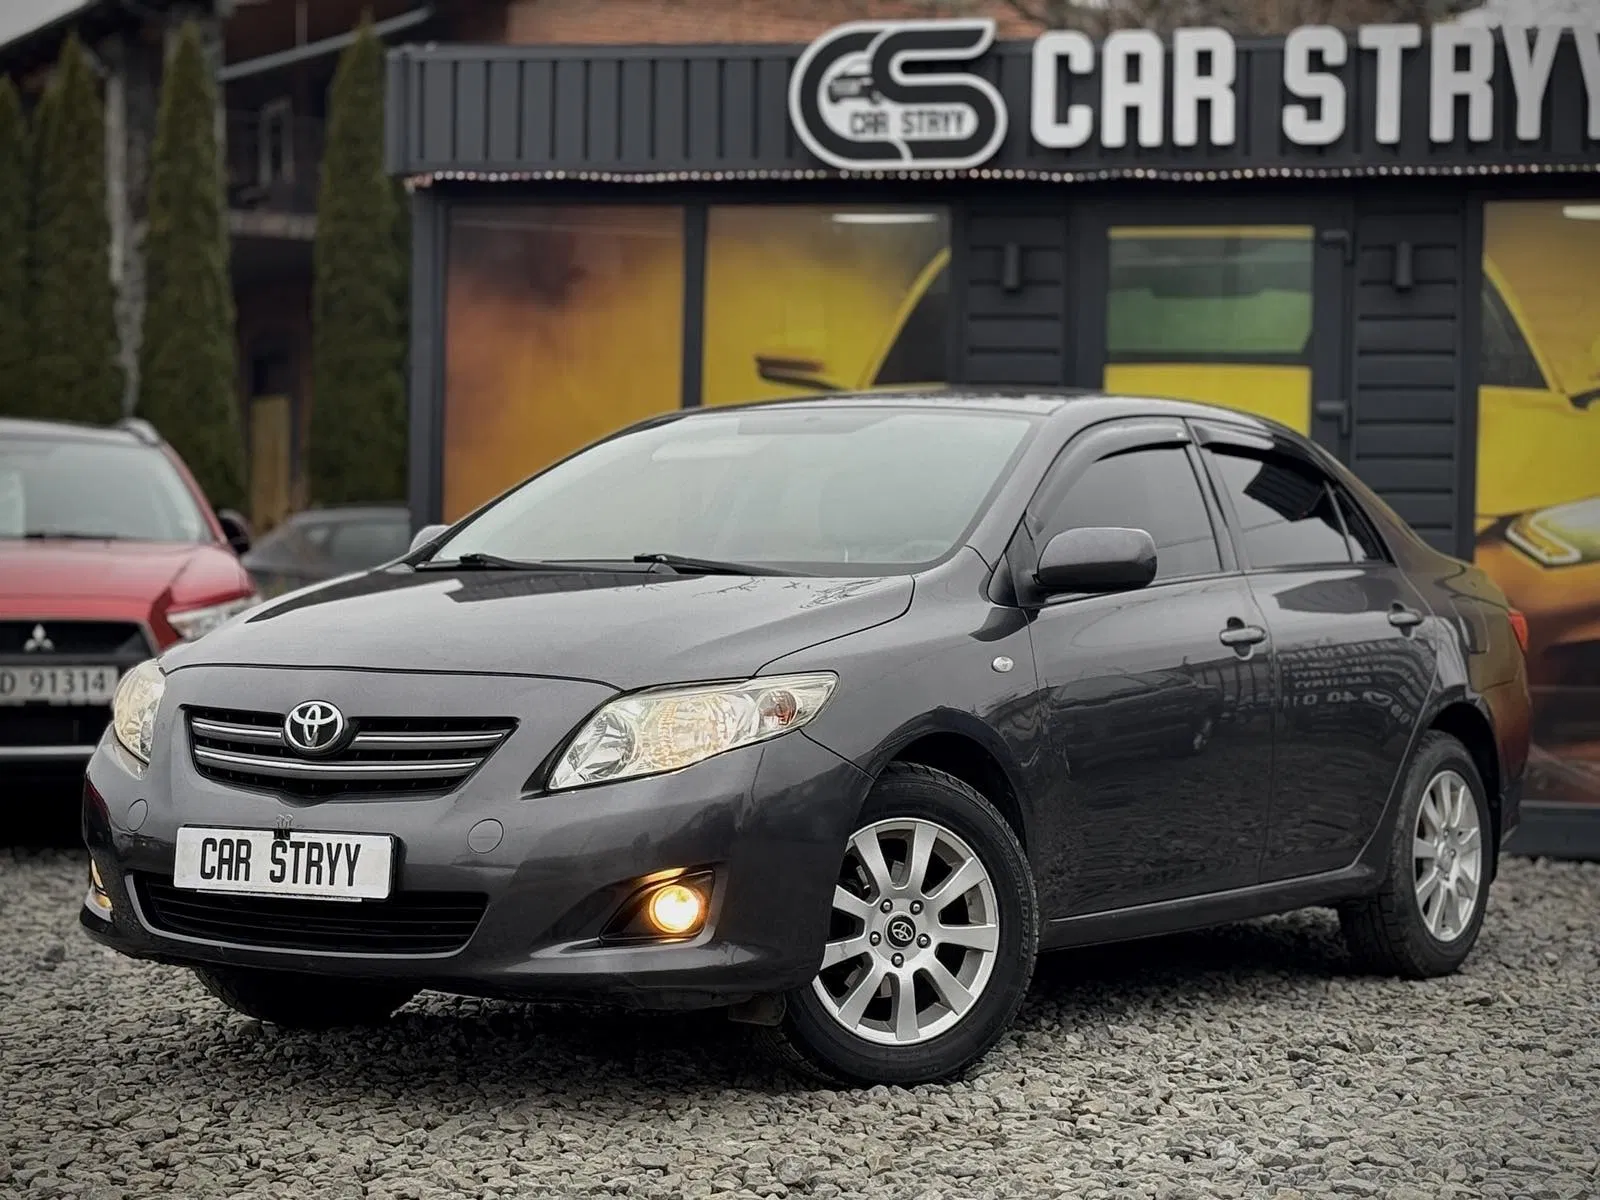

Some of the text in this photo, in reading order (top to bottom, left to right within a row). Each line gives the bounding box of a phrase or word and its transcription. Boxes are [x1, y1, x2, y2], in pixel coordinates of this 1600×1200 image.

[1031, 26, 1236, 148] CAR
[850, 109, 966, 134] CAR STRYY
[29, 669, 105, 694] 91314
[200, 837, 362, 887] CAR STRYY
